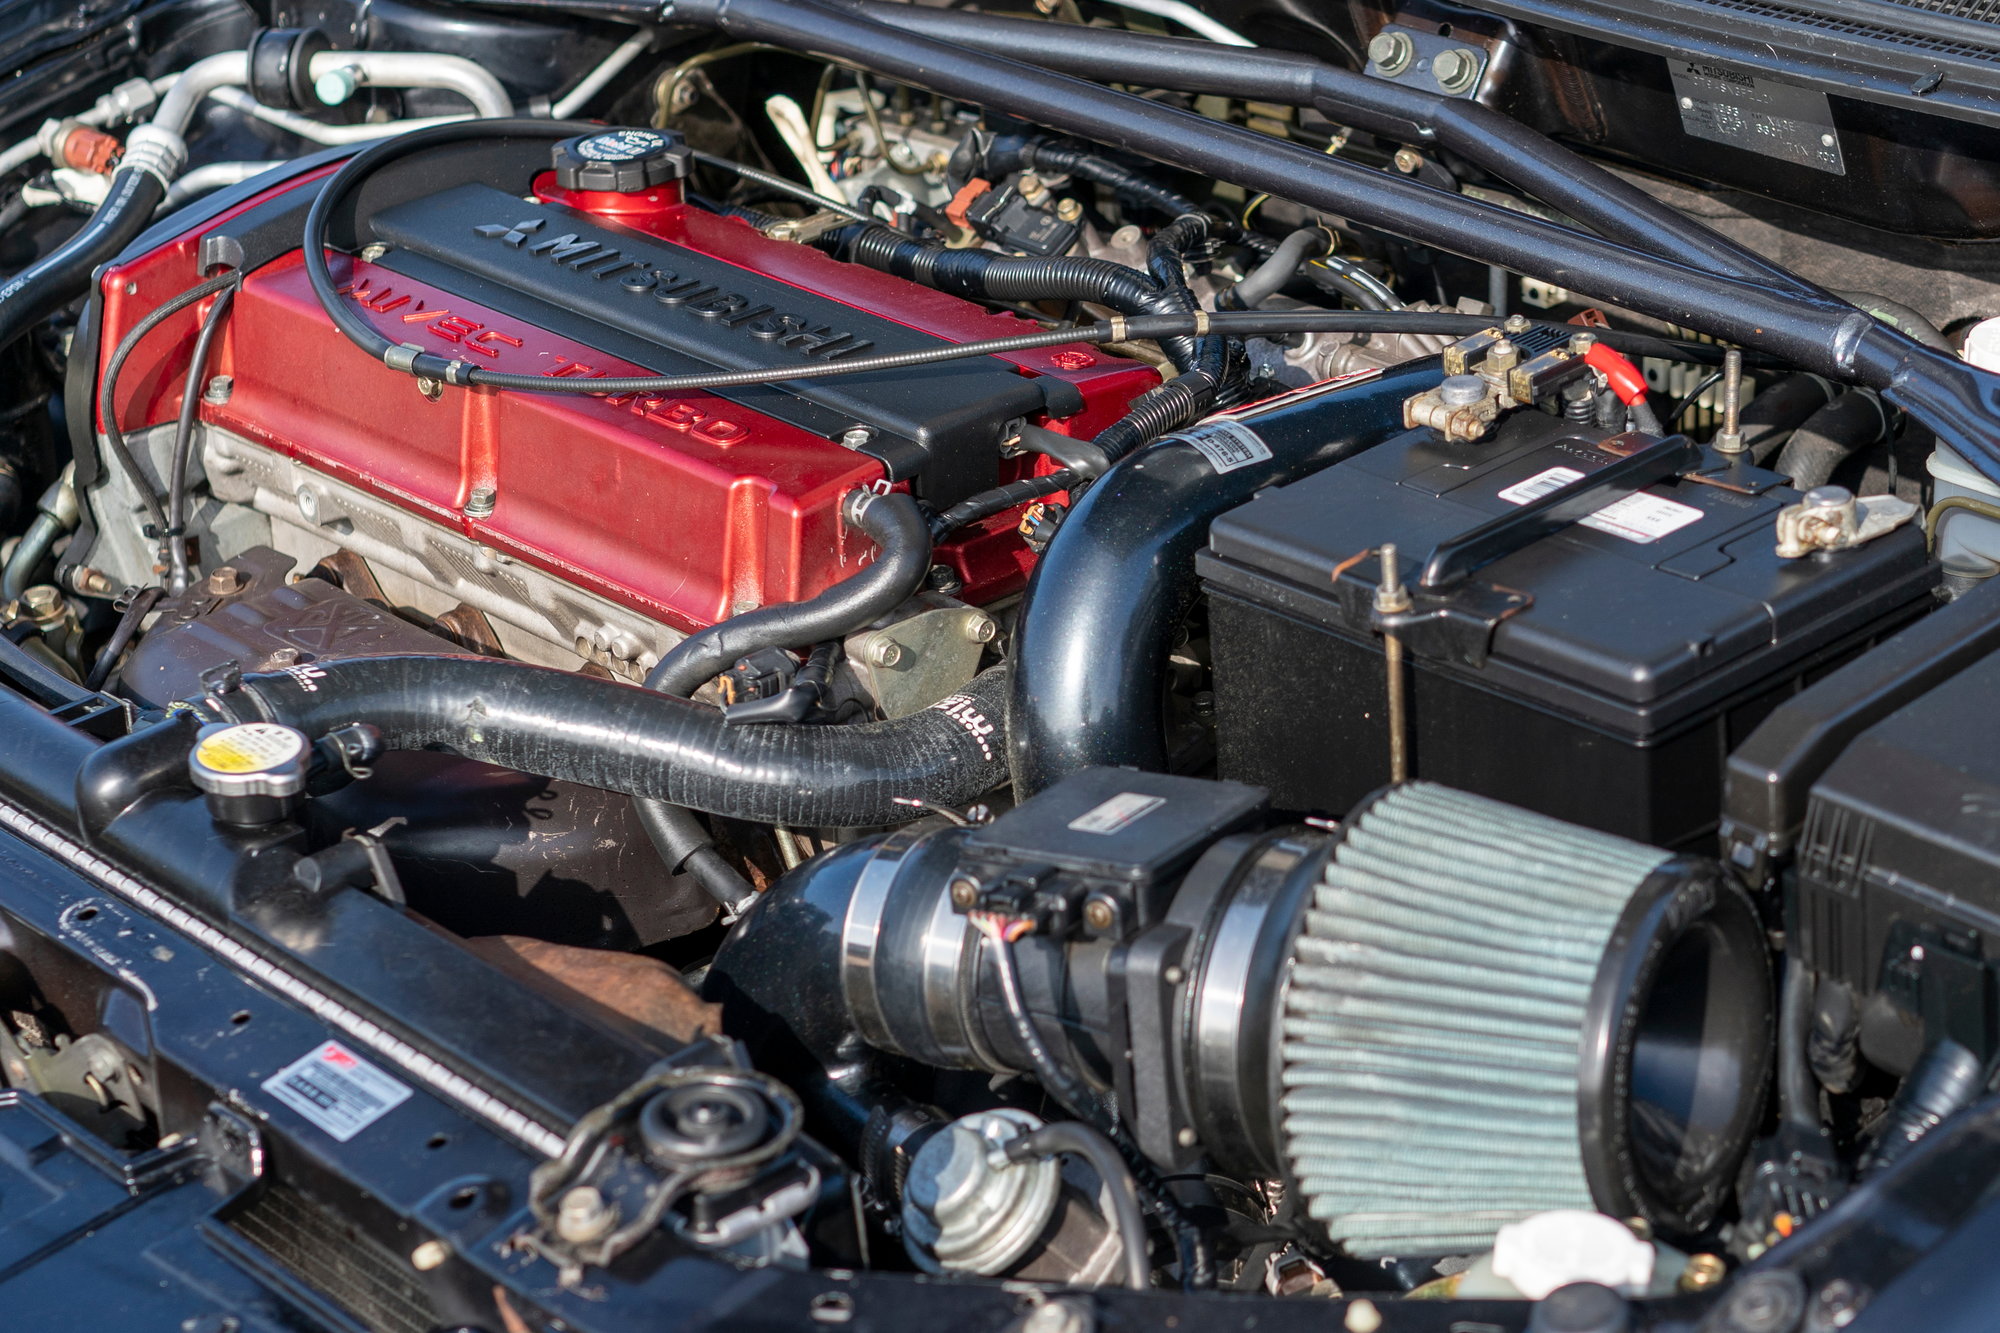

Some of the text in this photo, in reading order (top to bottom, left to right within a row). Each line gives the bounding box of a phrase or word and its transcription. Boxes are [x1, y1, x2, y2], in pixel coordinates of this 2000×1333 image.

[1702, 65, 1754, 84] MITSUBISHI
[529, 232, 873, 361] MITSUBISHI
[336, 278, 750, 447] MIVEC TRBO
